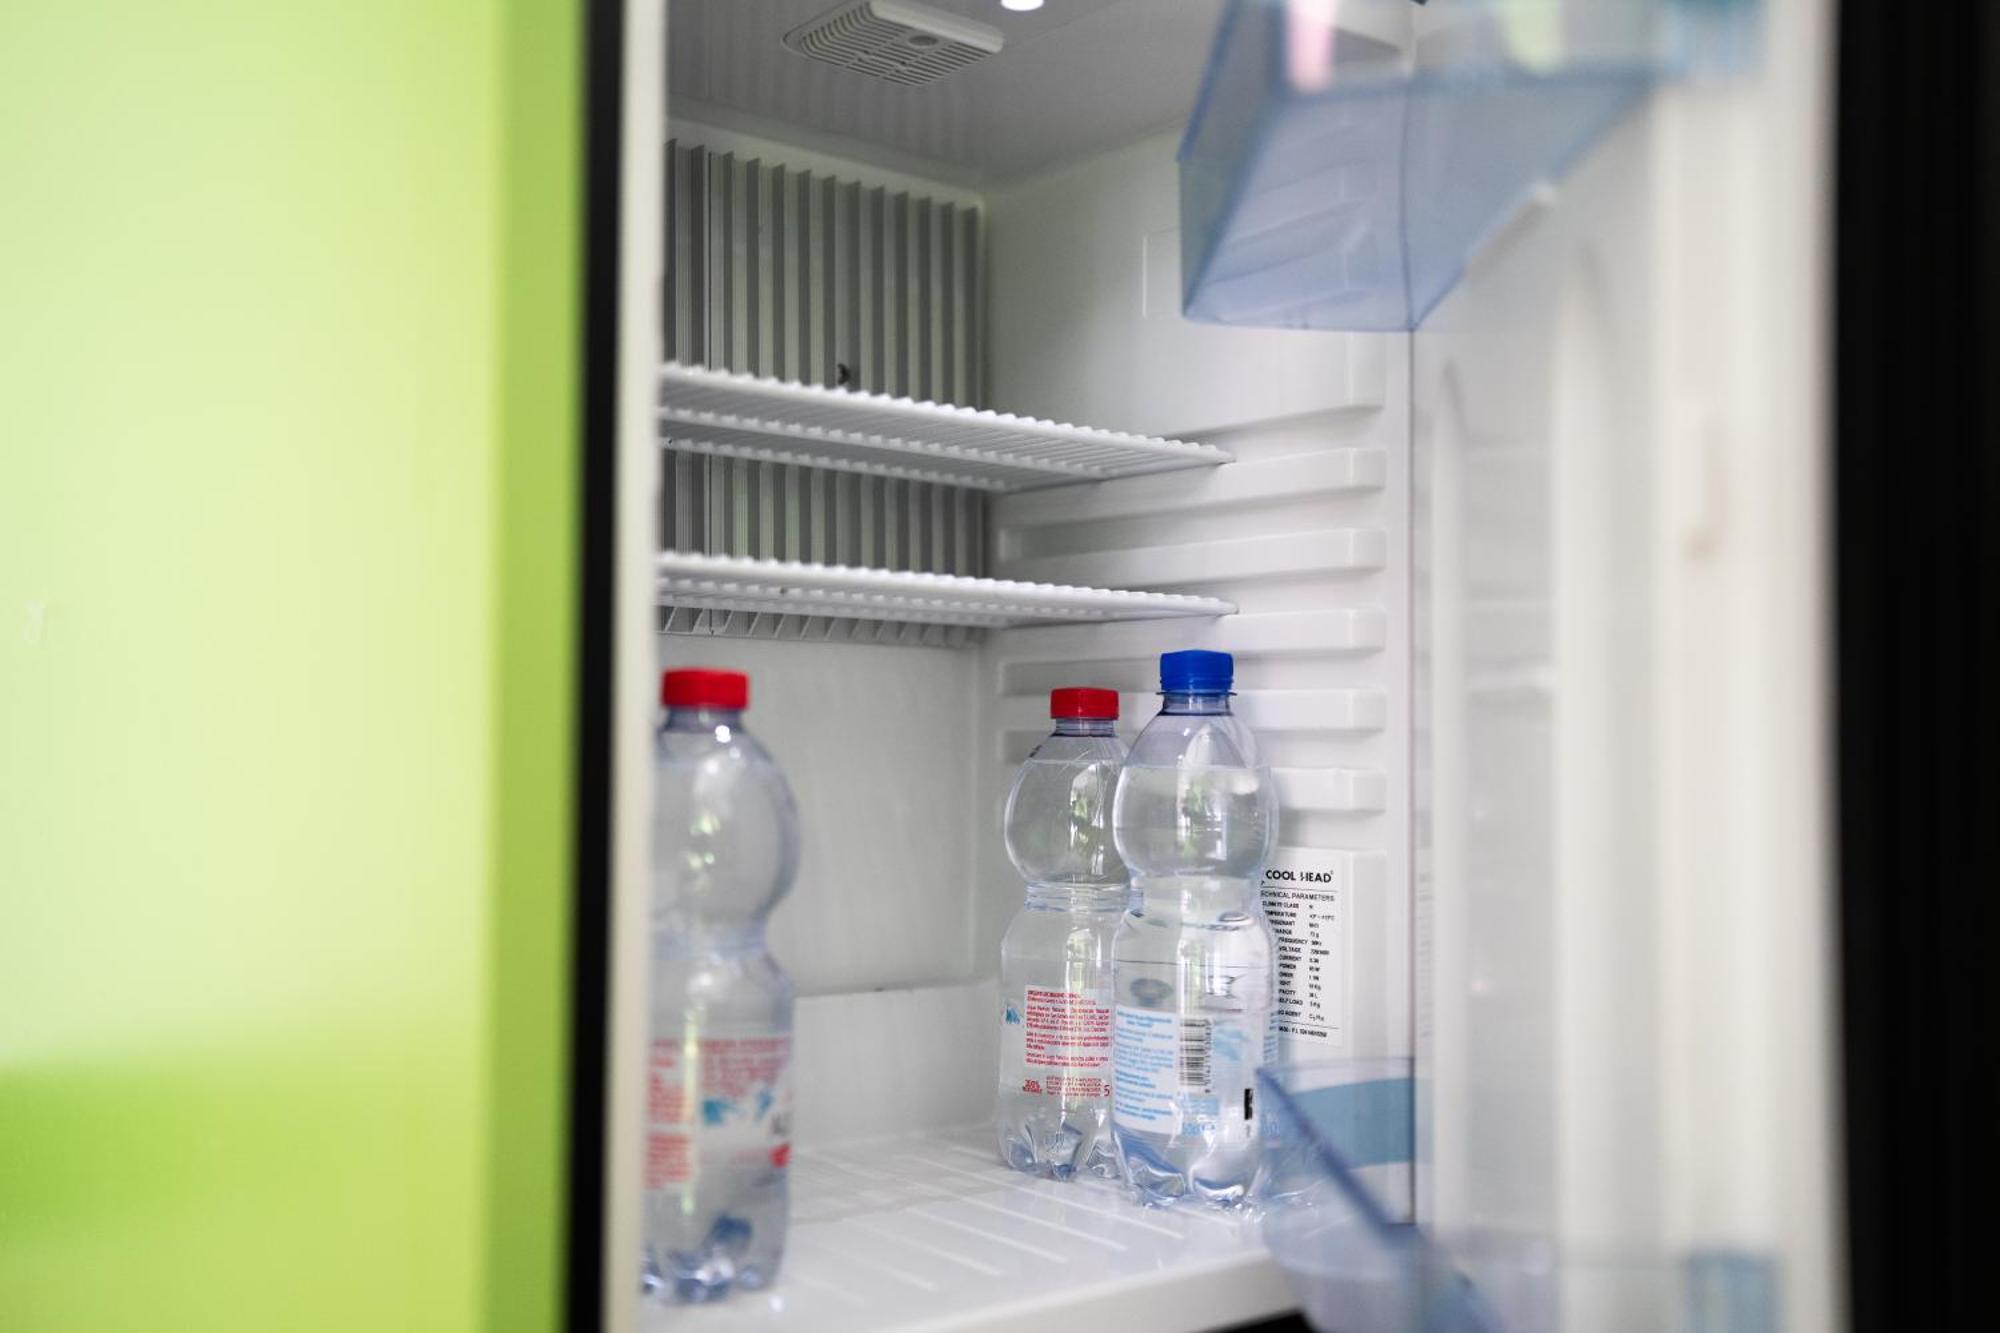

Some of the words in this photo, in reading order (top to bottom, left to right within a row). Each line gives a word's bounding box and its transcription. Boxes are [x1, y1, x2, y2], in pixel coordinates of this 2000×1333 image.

[1266, 870, 1296, 881] COOL
[1300, 872, 1332, 883] HEAD
[1261, 890, 1290, 899] ECHNICAL
[1292, 893, 1334, 901] PARAMETERS
